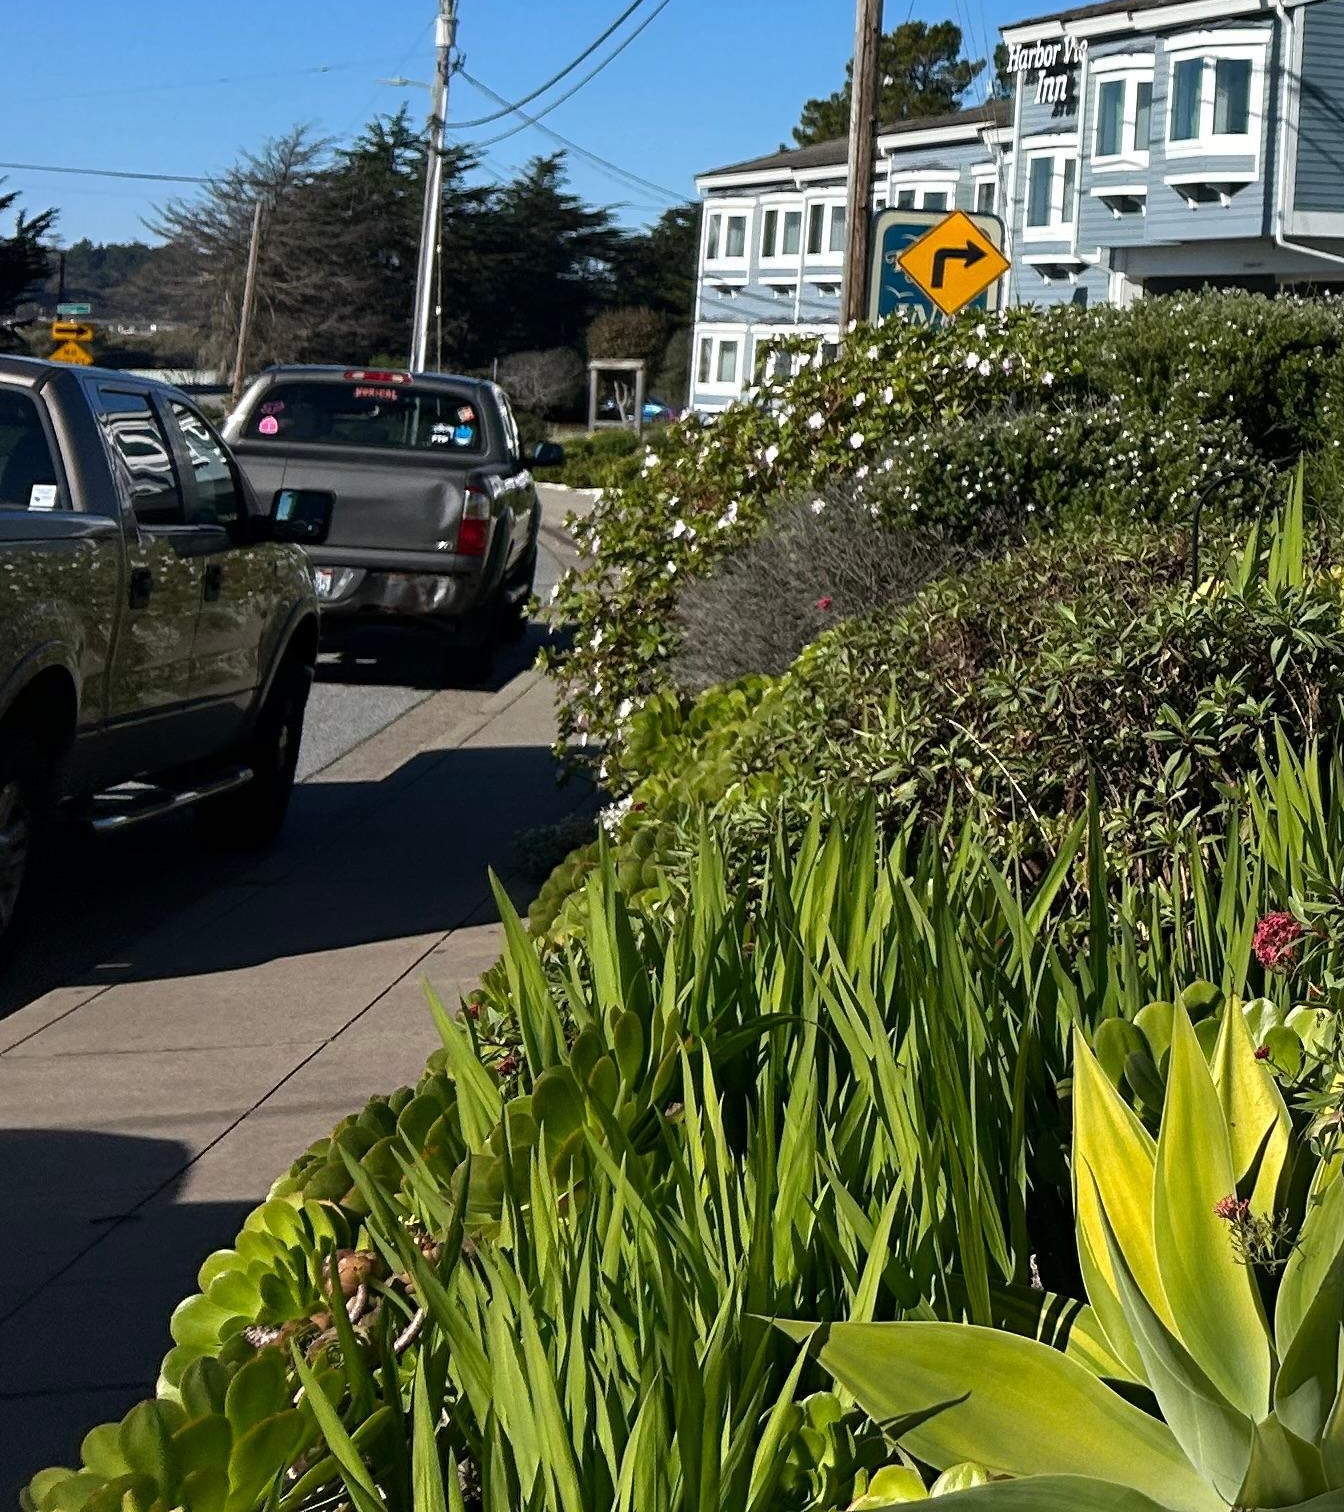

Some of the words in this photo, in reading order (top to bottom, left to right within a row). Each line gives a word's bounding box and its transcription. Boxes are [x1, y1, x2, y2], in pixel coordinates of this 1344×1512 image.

[1006, 40, 1061, 73] Harbor
[1063, 35, 1089, 64] Vie
[1034, 69, 1068, 105] Inn
